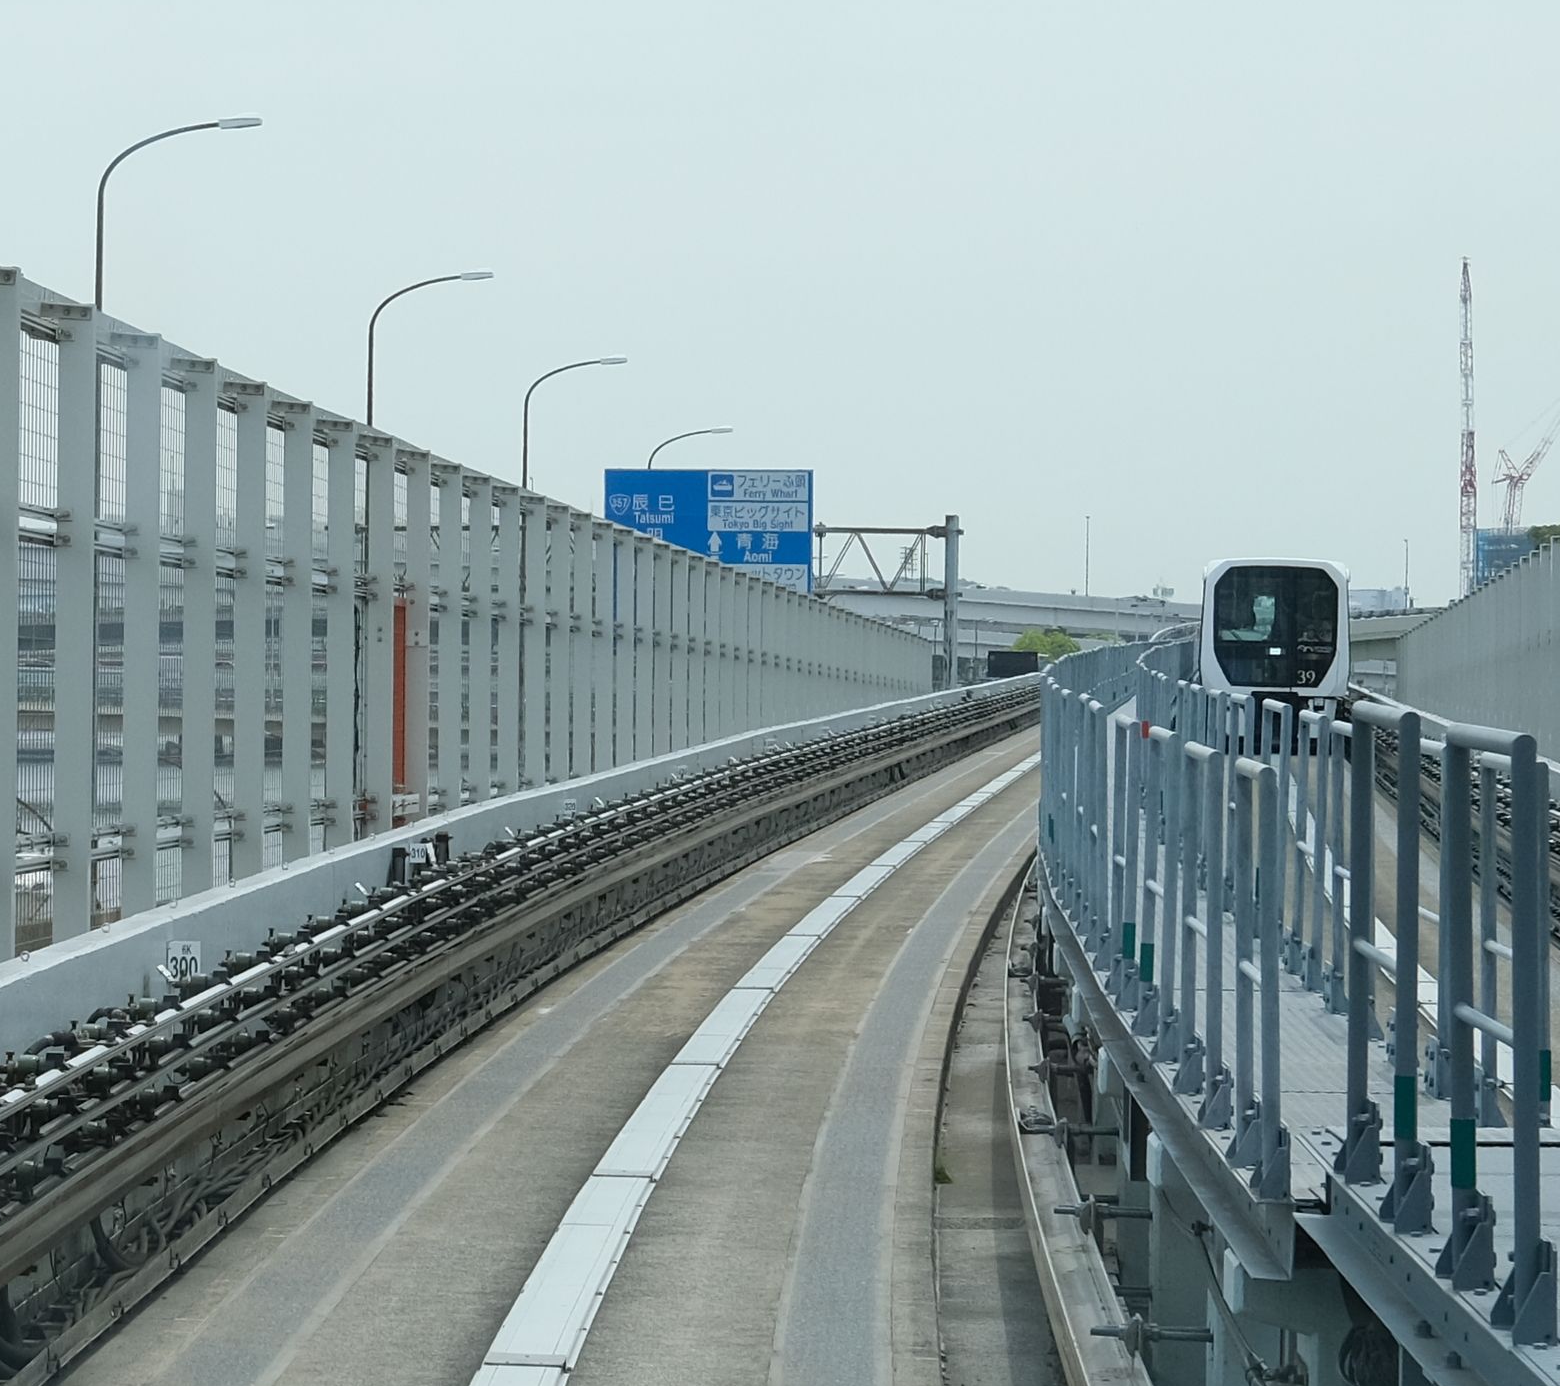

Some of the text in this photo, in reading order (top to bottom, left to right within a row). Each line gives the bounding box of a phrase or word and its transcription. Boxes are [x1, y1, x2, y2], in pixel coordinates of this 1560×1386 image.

[743, 489, 798, 500] Ferry Wharf
[634, 512, 675, 524] Tatsumi
[710, 505, 805, 519] 東京ビッグサイト
[722, 519, 794, 530] Tokyo Big Sight
[736, 533, 780, 550] 青海
[743, 551, 773, 563] Aomi
[1297, 669, 1316, 684] 39
[411, 848, 426, 859] 310
[170, 956, 198, 979] 300
